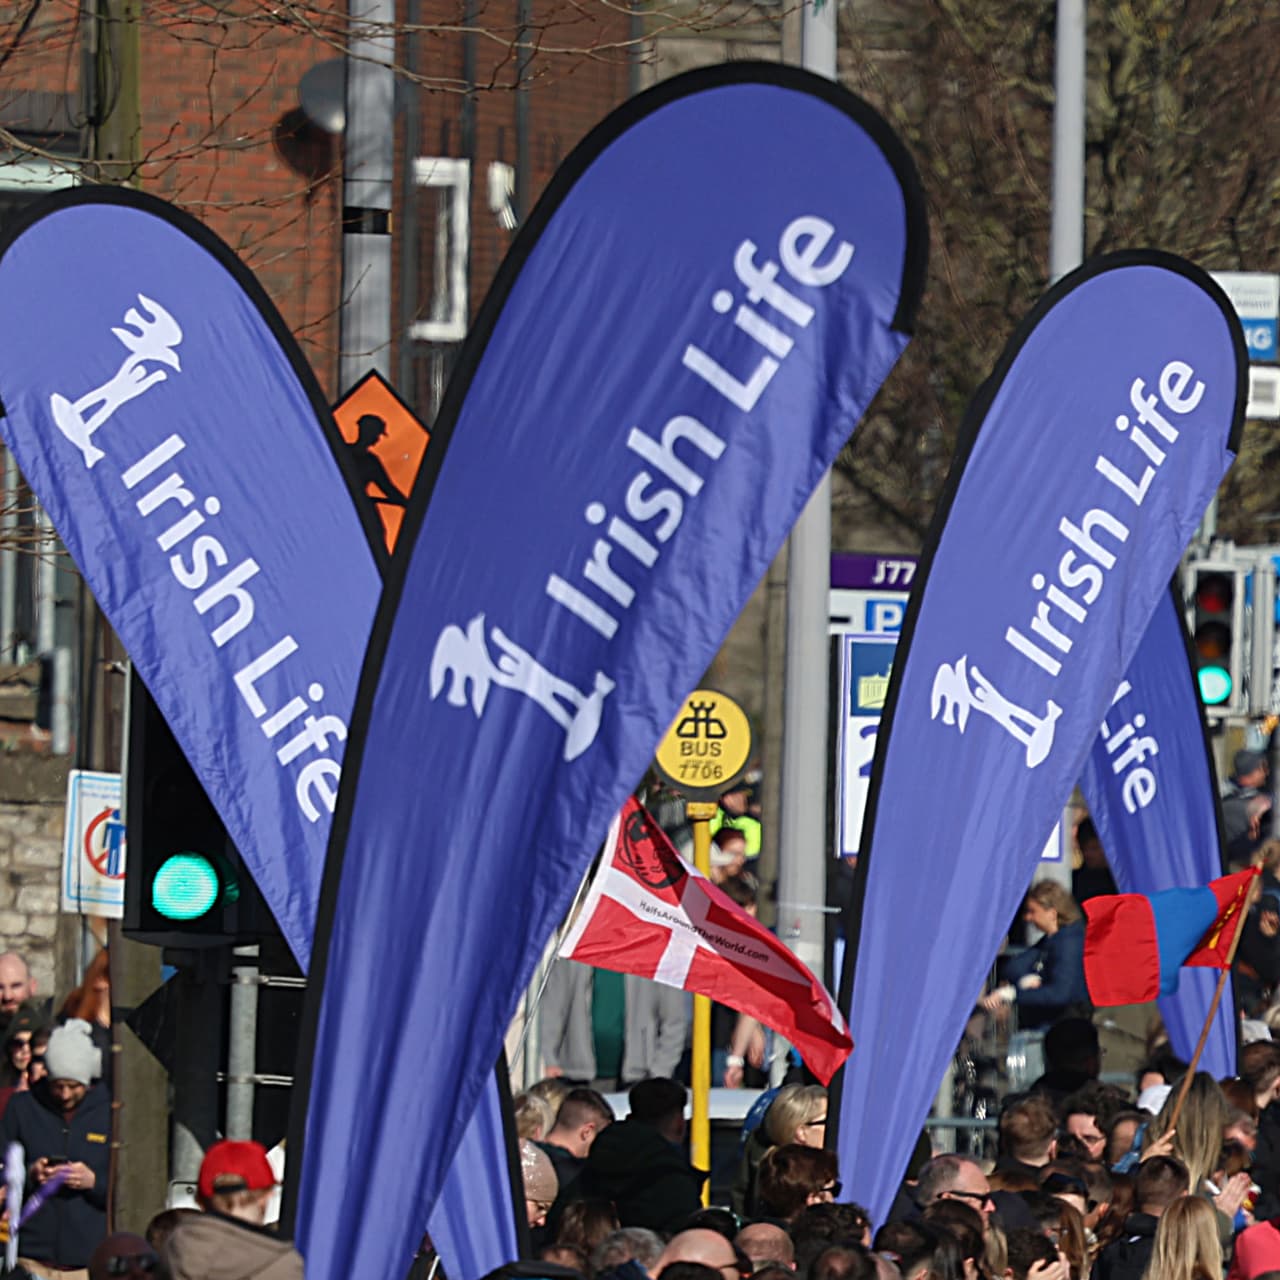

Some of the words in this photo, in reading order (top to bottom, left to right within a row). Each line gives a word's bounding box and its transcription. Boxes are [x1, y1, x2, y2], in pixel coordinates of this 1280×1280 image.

[546, 414, 727, 640] Irish
[682, 215, 854, 413] Life
[1005, 507, 1130, 676] Irish
[1094, 360, 1204, 505] Life
[121, 433, 260, 647] Irish
[233, 635, 348, 823] Life
[678, 764, 723, 780] 7706
[680, 741, 722, 758] BUS
